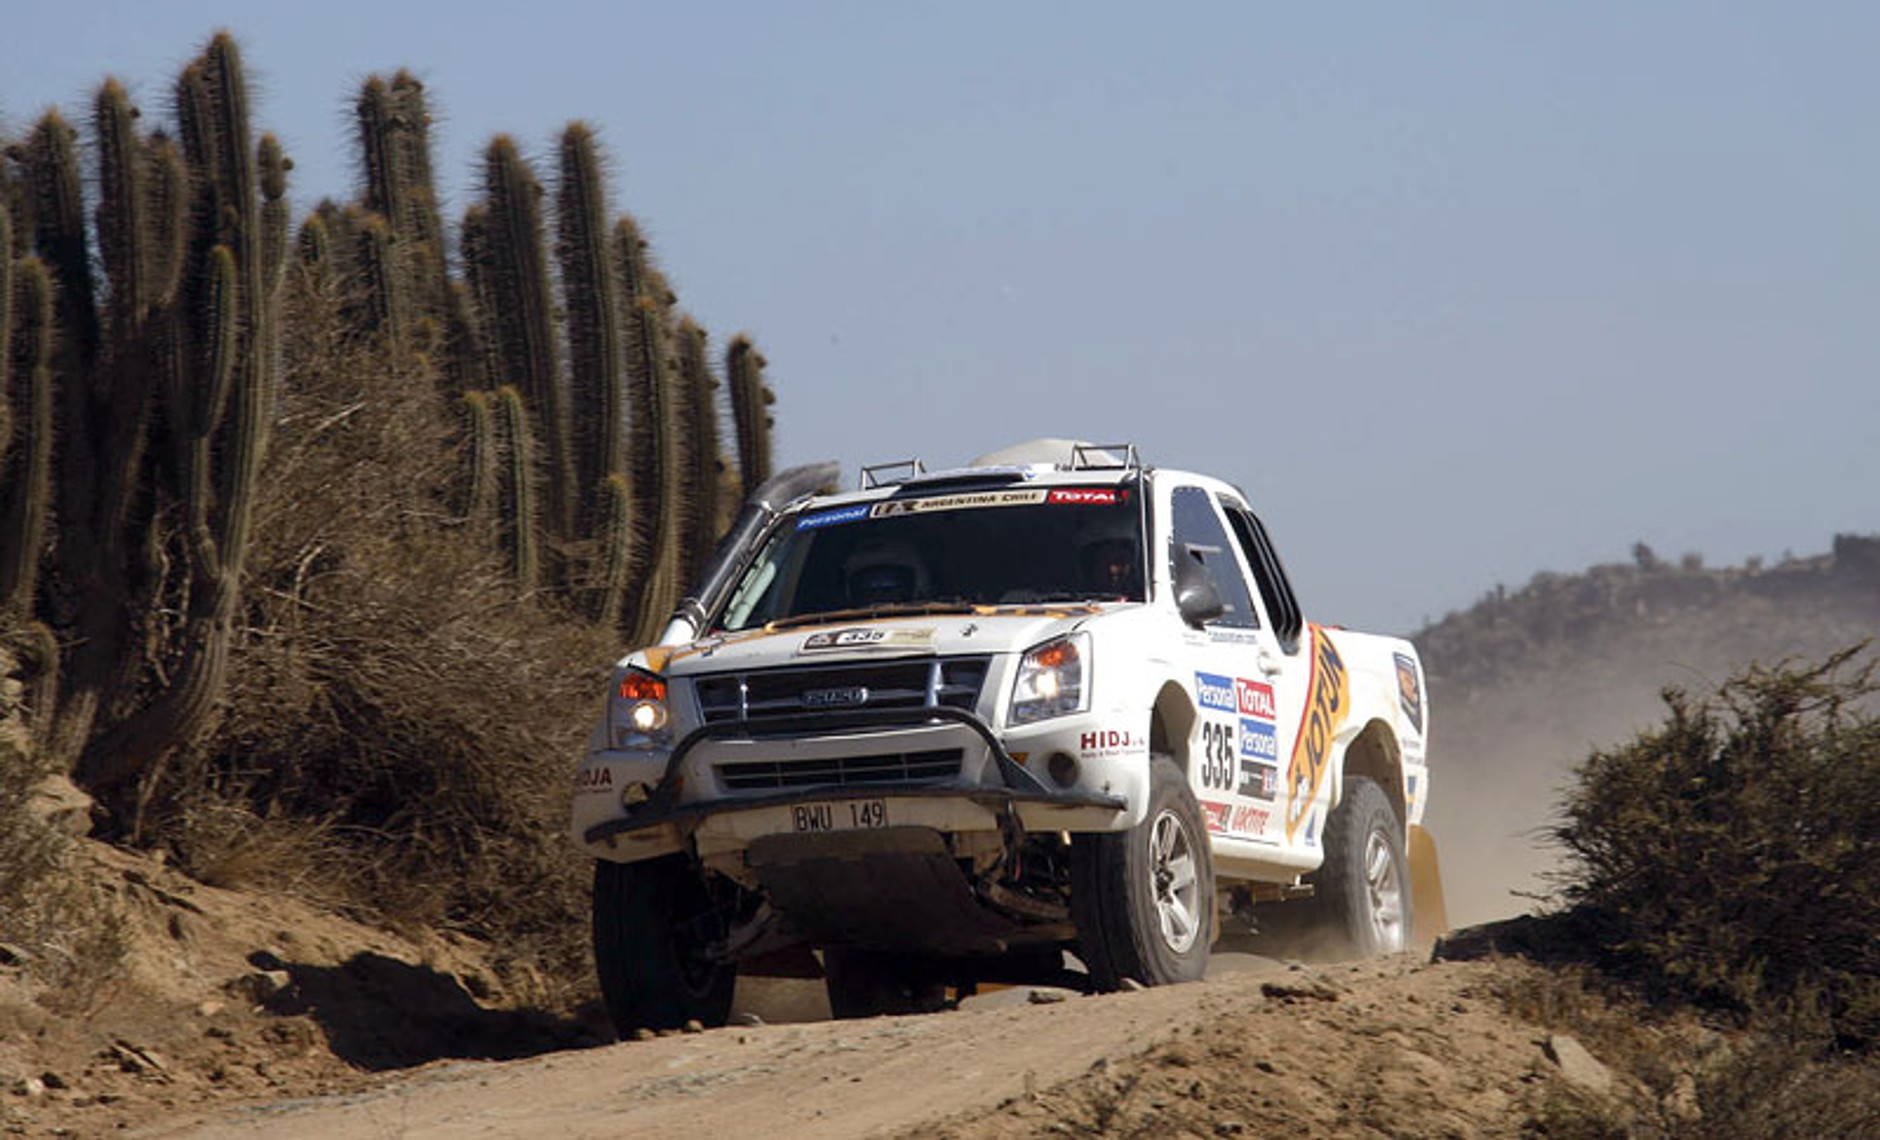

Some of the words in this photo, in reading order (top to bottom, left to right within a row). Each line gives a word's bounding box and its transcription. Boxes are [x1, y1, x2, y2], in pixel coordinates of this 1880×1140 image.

[920, 493, 997, 509] ARGENTINA
[1001, 492, 1037, 502] CHILE
[1052, 490, 1115, 501] TOTAL
[798, 507, 868, 528] Personal
[844, 630, 885, 641] 335
[1197, 677, 1237, 709] Personal
[1237, 682, 1277, 717] TOTAL
[1305, 630, 1344, 792] JOTUN
[1202, 720, 1236, 791] 335
[1240, 724, 1277, 757] Personal
[795, 805, 833, 831] BWU
[849, 801, 883, 828] 149
[1231, 803, 1271, 836] LOCTITE
